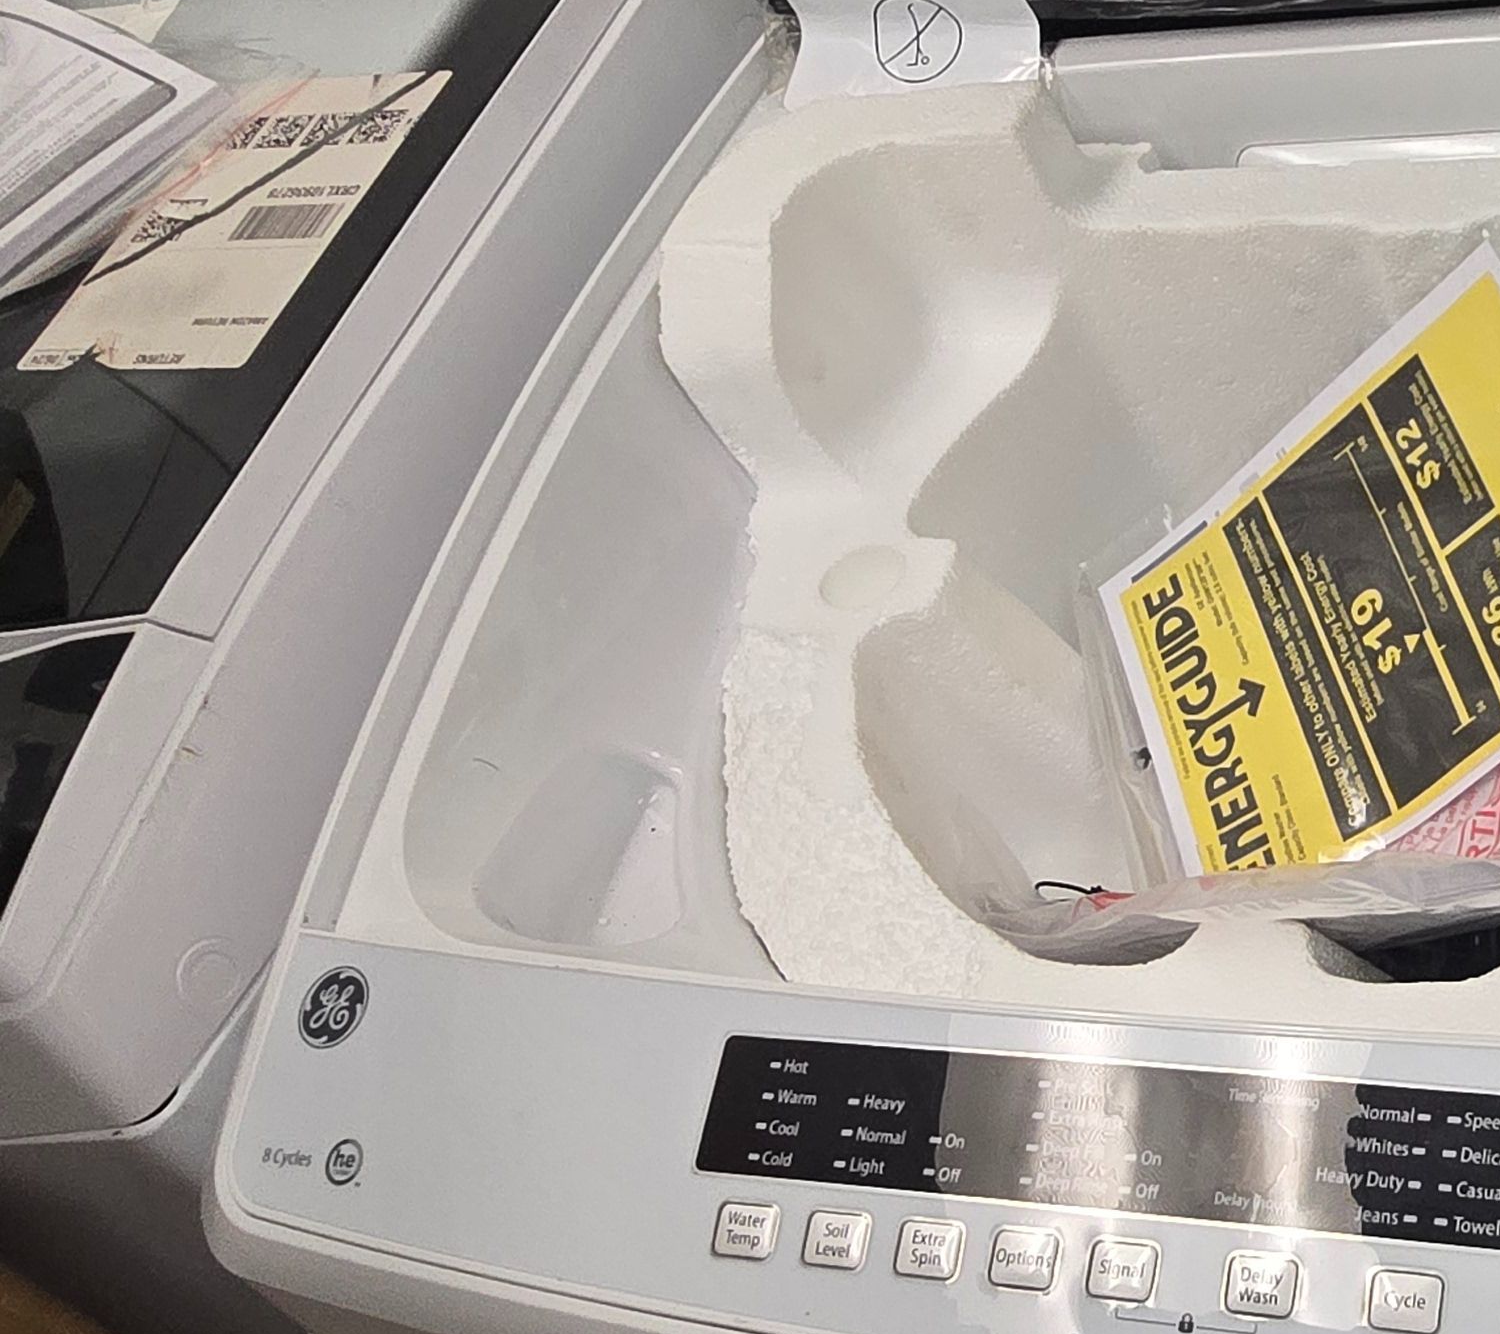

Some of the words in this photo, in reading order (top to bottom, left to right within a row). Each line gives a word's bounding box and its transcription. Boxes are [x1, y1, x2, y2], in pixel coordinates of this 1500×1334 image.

[1394, 417, 1441, 489] $12
[1299, 550, 1318, 582] Cost
[1256, 573, 1282, 614] yellow
[1312, 579, 1336, 624] Energy
[1271, 612, 1290, 641] with
[1350, 587, 1402, 674] $19
[1329, 620, 1351, 663] Yearly
[1283, 639, 1305, 681] labels
[1298, 678, 1319, 713] other
[1343, 658, 1377, 723] Estimated
[1312, 712, 1325, 730] to
[1314, 729, 1340, 767] ONLY
[783, 1059, 809, 1074] Hot
[777, 1089, 817, 1106] Warm
[863, 1095, 905, 1114] Heavy
[1359, 1104, 1415, 1123] Normal
[769, 1120, 800, 1136] Cool
[856, 1127, 906, 1145] Normal
[945, 1133, 965, 1149] On
[1355, 1137, 1409, 1156] Whites
[262, 1147, 271, 1163] 8
[274, 1148, 312, 1167] Cycles
[762, 1151, 793, 1167] Cold
[850, 1157, 885, 1176] Light
[1141, 1150, 1162, 1166] On
[938, 1167, 961, 1183] Off
[1315, 1168, 1363, 1188] Heavy
[1366, 1172, 1404, 1192] Duty
[1135, 1184, 1160, 1200] Off
[727, 1211, 767, 1228] Water
[1355, 1206, 1399, 1225] Jeans
[726, 1229, 760, 1249] Temp
[824, 1222, 849, 1238] Soil
[912, 1231, 946, 1247] Extra
[815, 1242, 850, 1259] Level
[910, 1249, 942, 1268] Spin
[995, 1247, 1052, 1269] Options
[1099, 1260, 1146, 1280] Signal
[1384, 1290, 1426, 1311] Cycle
